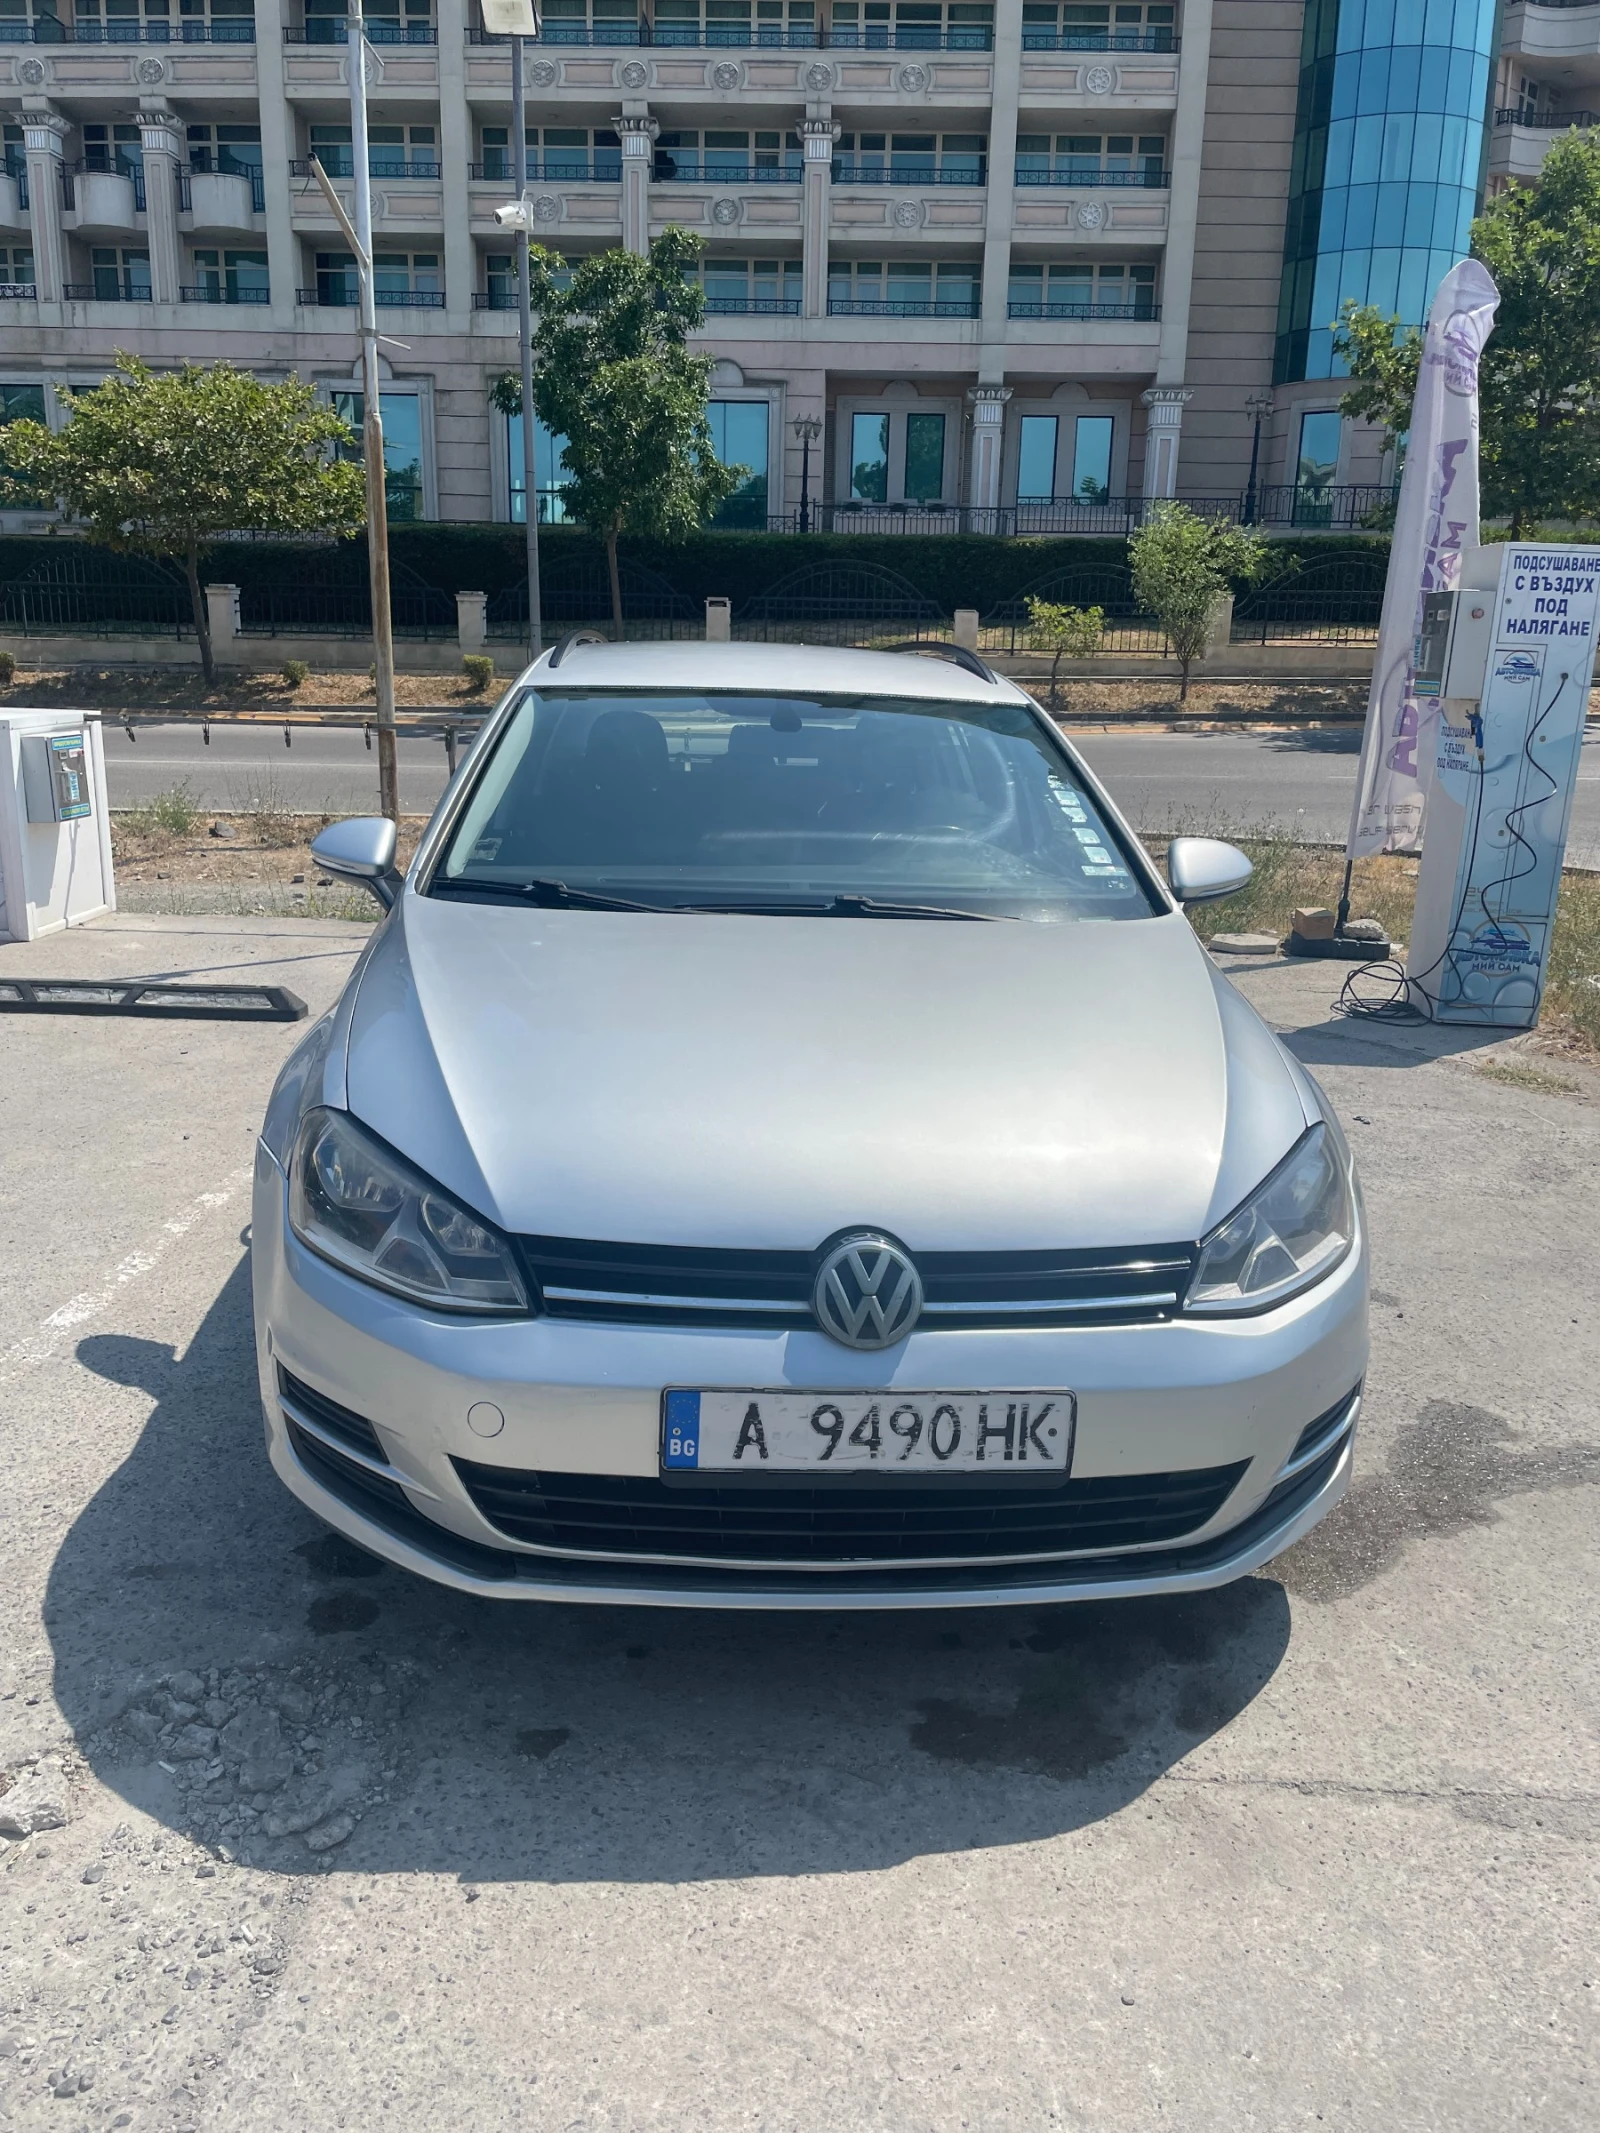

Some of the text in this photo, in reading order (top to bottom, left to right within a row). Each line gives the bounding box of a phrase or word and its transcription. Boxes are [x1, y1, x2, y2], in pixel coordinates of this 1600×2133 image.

[1513, 555, 1600, 573] ПОДСУШАВАНЕ
[1515, 575, 1595, 595] С ВЪЗДУХ
[1534, 597, 1568, 617] ПОД
[1506, 618, 1590, 636] НАЛЯГАНЕ
[732, 1402, 769, 1459] A
[810, 1403, 961, 1461] 9490
[669, 1438, 695, 1457] BG
